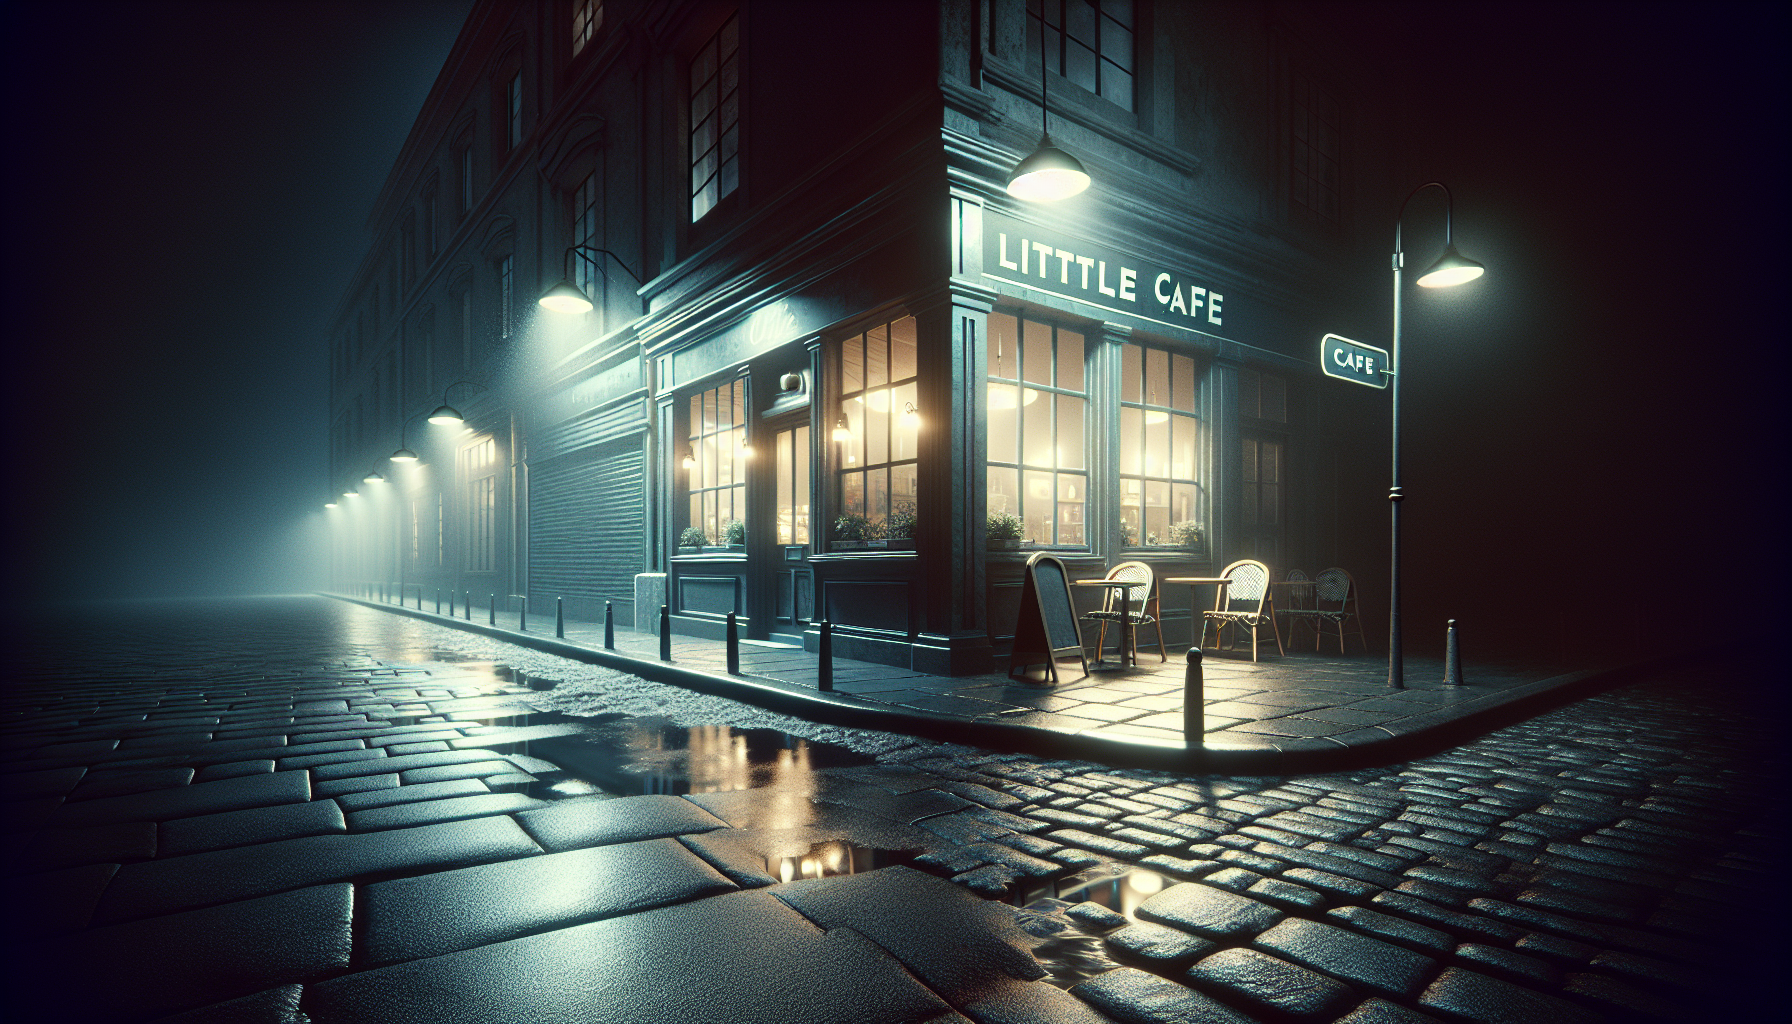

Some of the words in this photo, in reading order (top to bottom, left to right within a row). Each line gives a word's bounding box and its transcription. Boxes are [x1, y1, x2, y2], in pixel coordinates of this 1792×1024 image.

[999, 233, 1137, 302] LITTTLE
[1154, 272, 1224, 326] CAFE
[1333, 348, 1374, 375] CAFE
